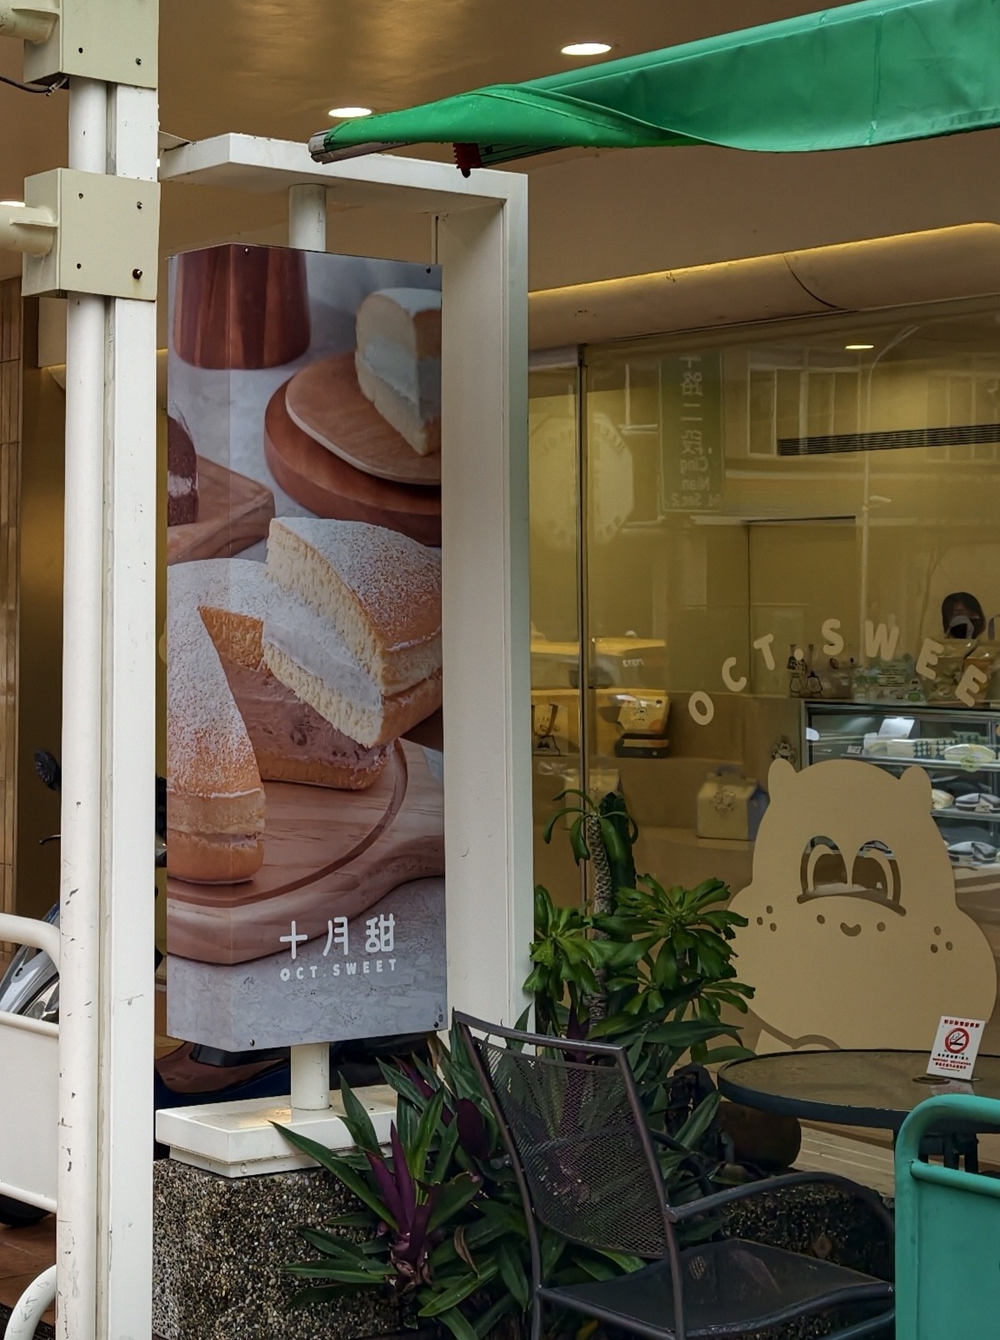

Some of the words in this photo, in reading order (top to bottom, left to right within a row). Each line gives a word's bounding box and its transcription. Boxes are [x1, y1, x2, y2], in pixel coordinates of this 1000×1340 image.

[688, 618, 1000, 738] OCT.SWEE
[279, 913, 396, 960] 十月甜
[279, 959, 397, 982] OCT.SWEET
